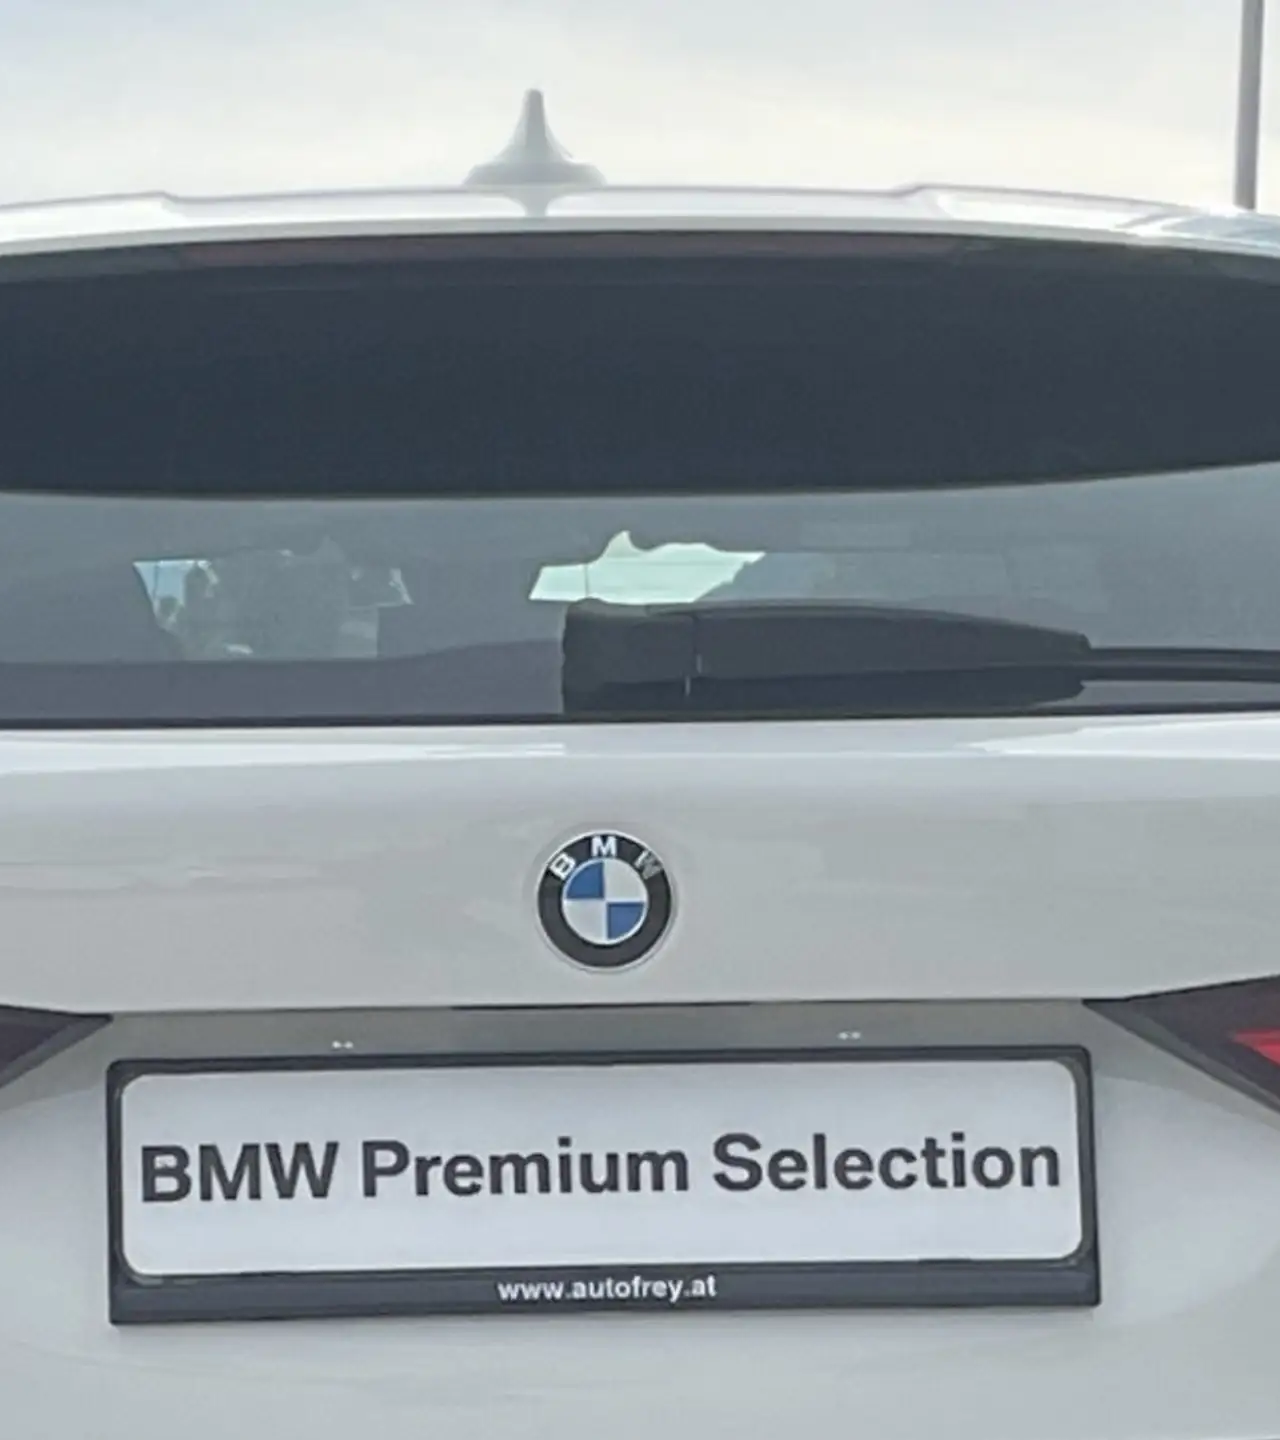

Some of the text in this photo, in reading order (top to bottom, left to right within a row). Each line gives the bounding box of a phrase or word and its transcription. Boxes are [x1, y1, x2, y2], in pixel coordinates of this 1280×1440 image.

[548, 836, 663, 880] BMW
[140, 1131, 1060, 1202] BMW Premium Selection
[497, 1275, 717, 1303] www.autofrey.at
